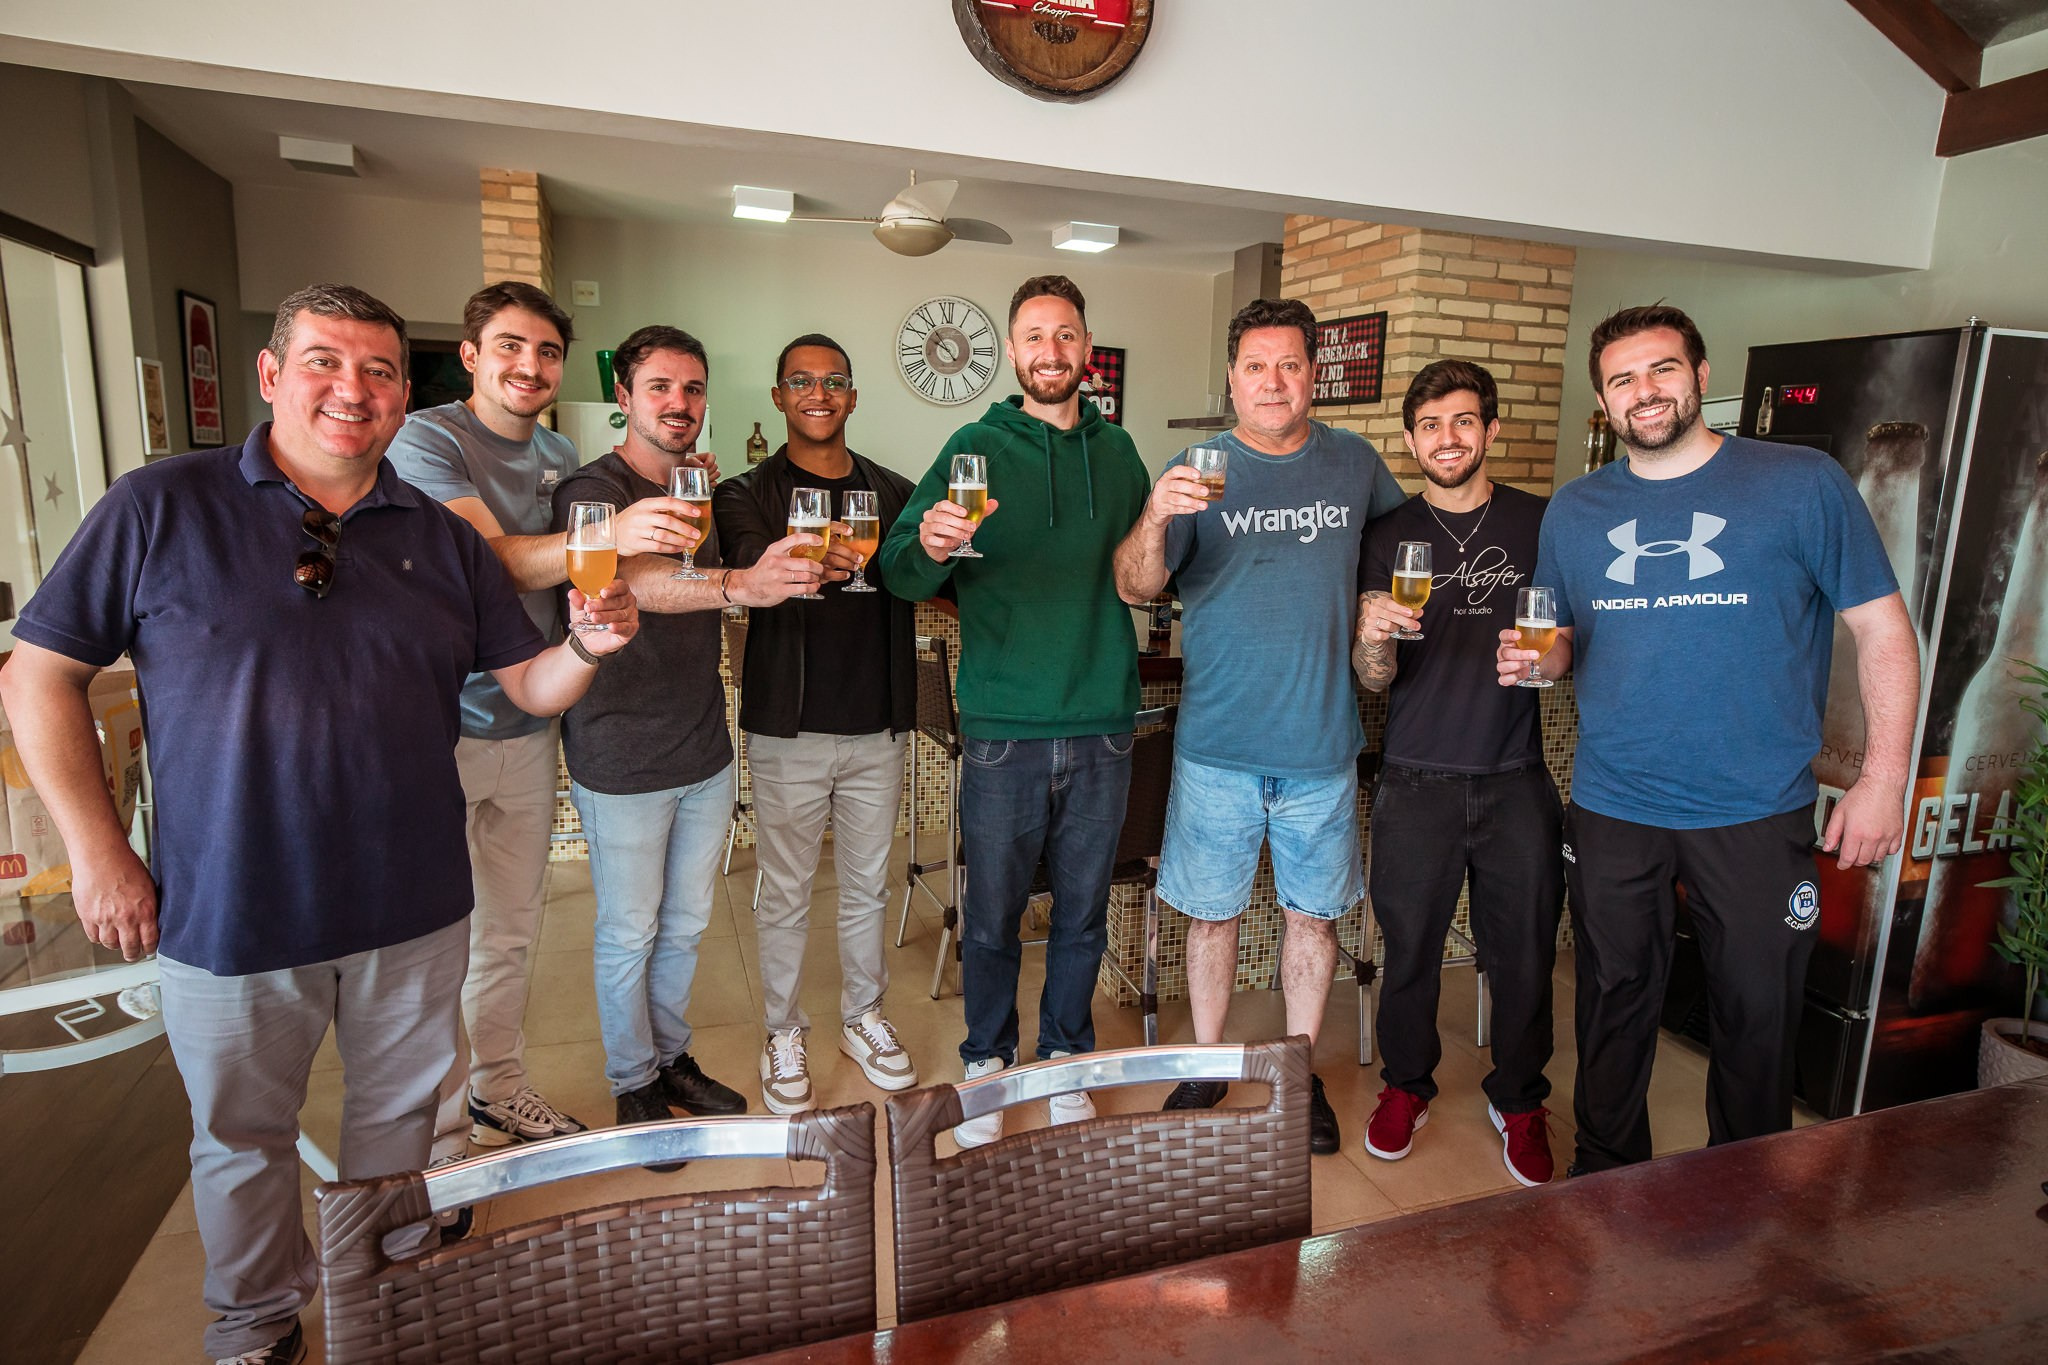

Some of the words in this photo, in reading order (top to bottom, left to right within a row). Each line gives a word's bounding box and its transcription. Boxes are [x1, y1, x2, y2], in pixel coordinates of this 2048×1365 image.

[1033, 1, 1083, 18] Chopp
[1324, 328, 1339, 345] I'M
[1341, 326, 1348, 343] A
[1317, 342, 1368, 364] MBERJACK
[1320, 365, 1344, 382] AND
[1312, 383, 1329, 399] I'M
[1331, 381, 1350, 398] OK!
[1220, 500, 1349, 543] Wrangler
[1453, 607, 1466, 615] hair
[1468, 606, 1493, 615] studio
[1592, 598, 1648, 611] UNDER
[1653, 593, 1748, 608] ARMOUR
[1911, 789, 2030, 860] GELA
